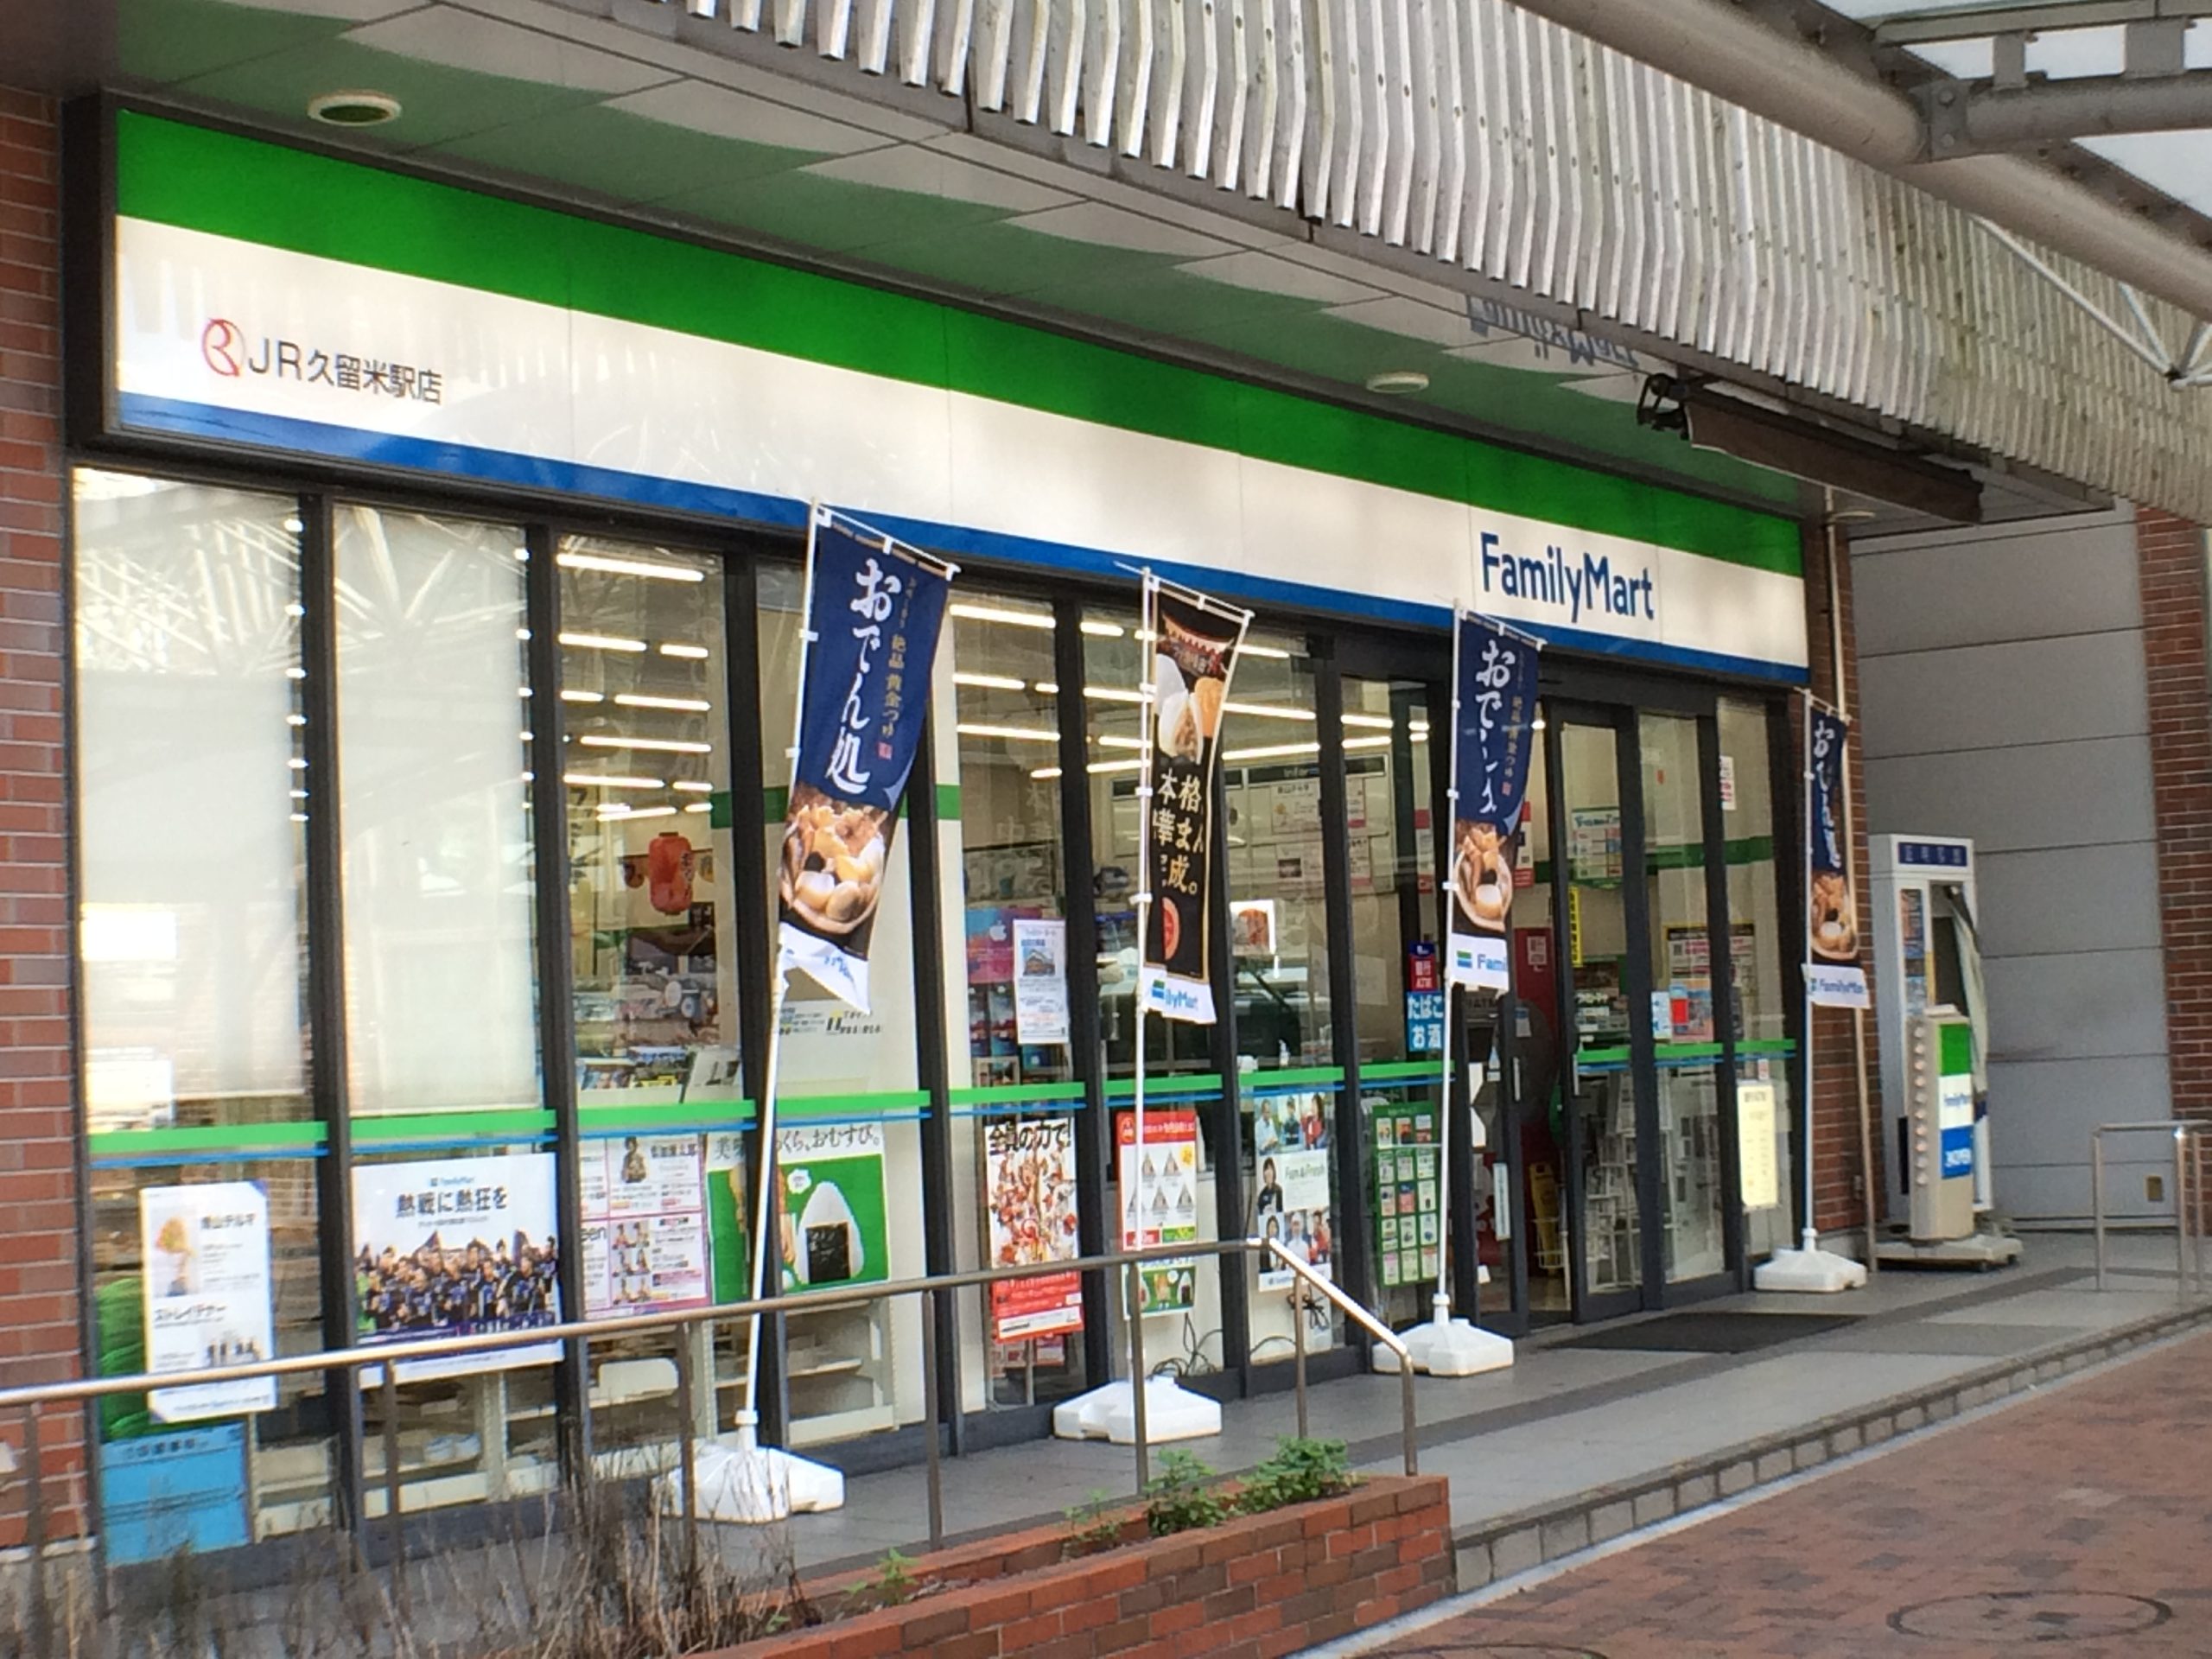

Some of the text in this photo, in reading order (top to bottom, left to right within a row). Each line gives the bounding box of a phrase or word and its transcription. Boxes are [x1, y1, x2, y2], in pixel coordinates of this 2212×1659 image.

[249, 338, 442, 404] JR久留米駅店
[1480, 531, 1655, 623] FamilyMart
[823, 558, 901, 795] おでん処
